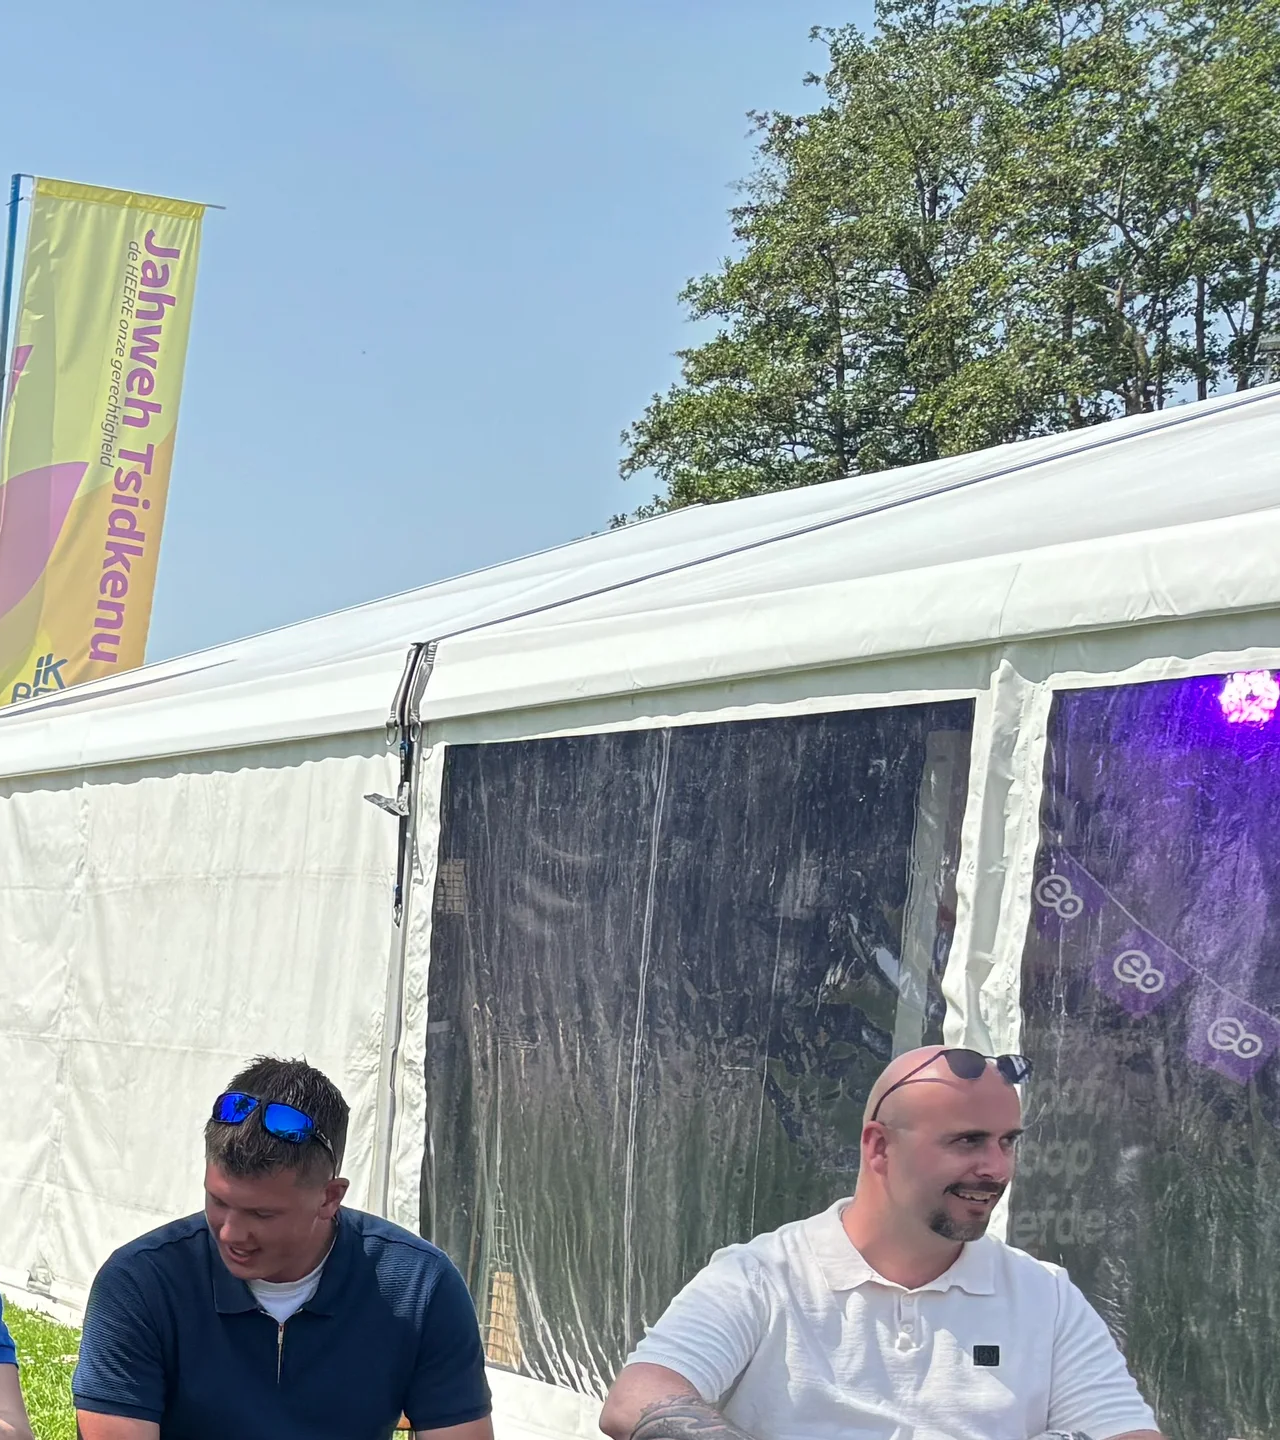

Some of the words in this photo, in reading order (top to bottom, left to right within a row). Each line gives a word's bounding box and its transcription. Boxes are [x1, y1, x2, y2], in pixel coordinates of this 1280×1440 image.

[120, 263, 139, 319] HEERE
[128, 241, 142, 261] de
[115, 319, 129, 358] onze
[122, 228, 181, 428] Jahweh
[100, 358, 124, 468] gerechtigheid
[89, 443, 155, 664] Tsidkenu
